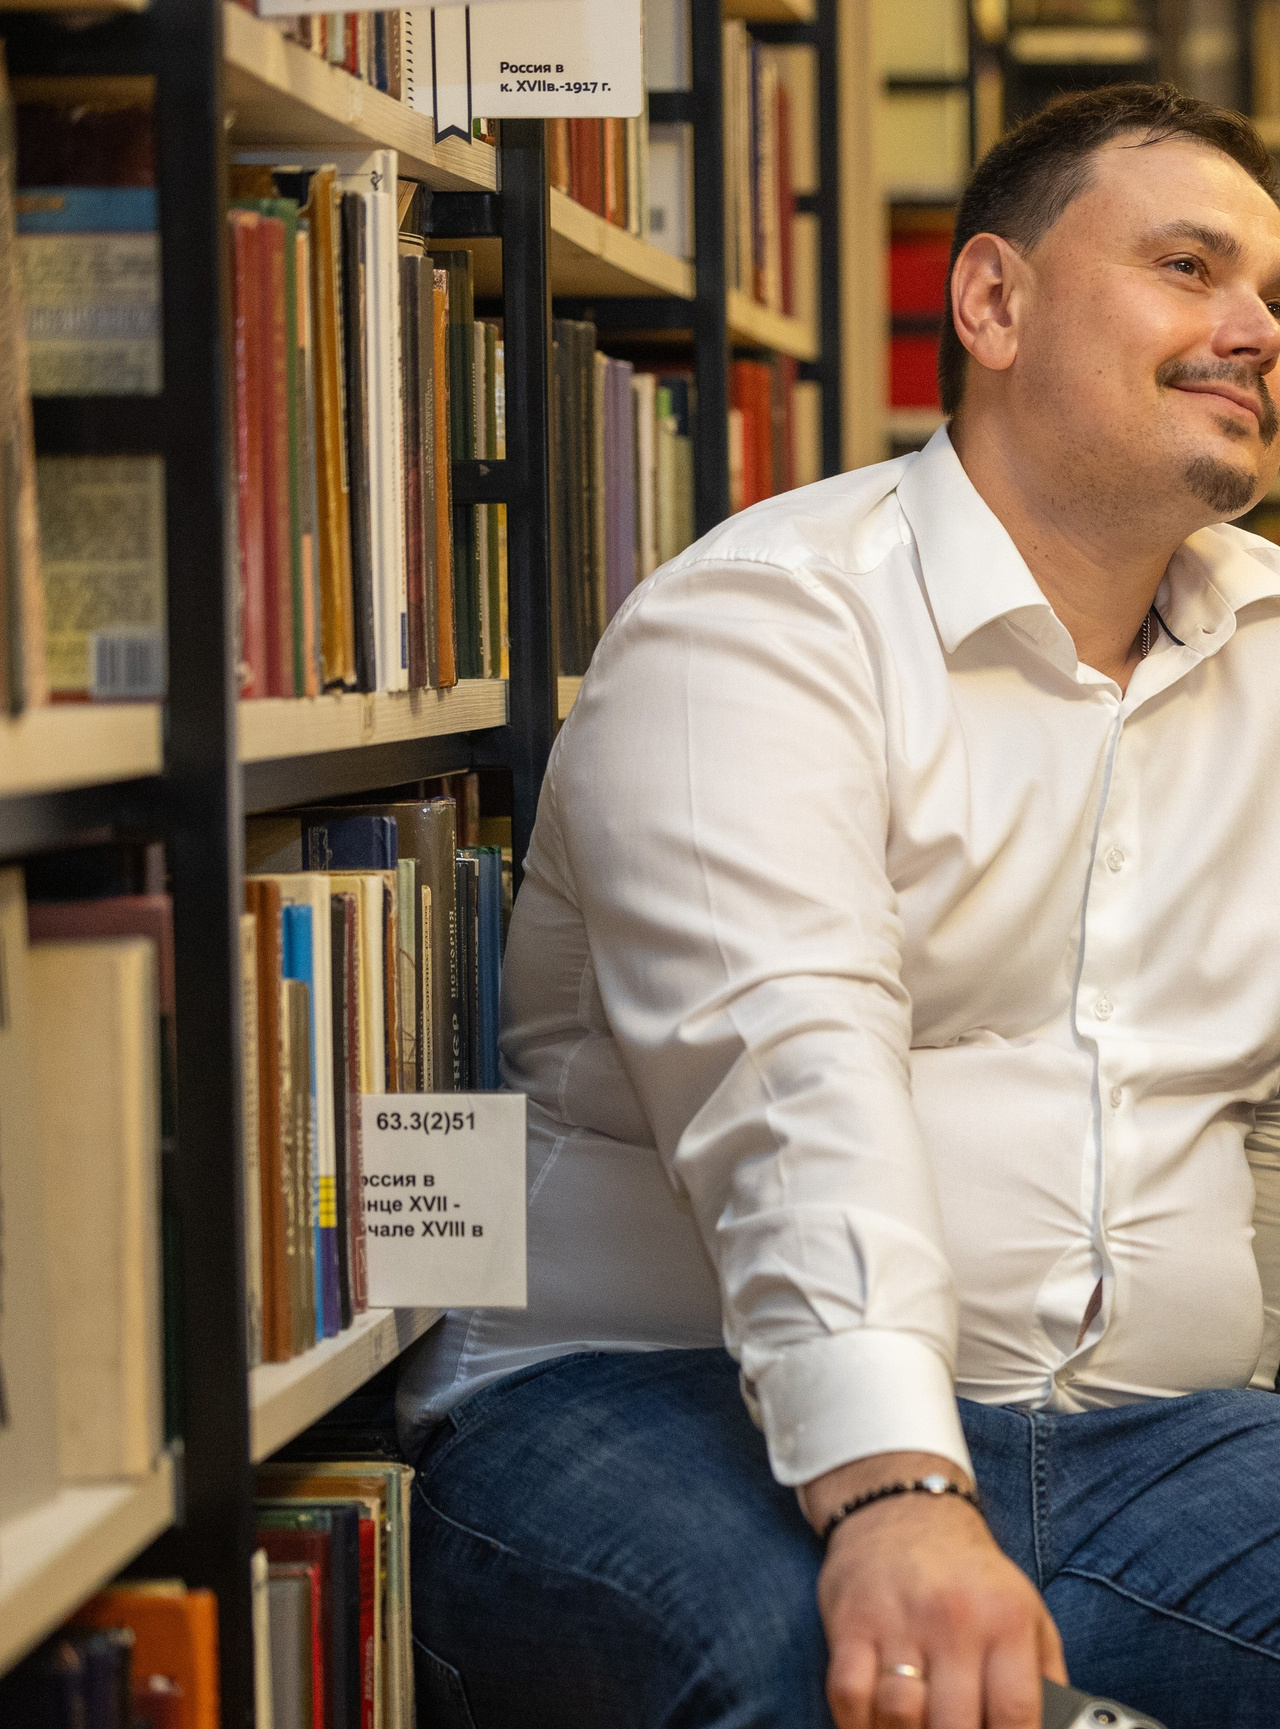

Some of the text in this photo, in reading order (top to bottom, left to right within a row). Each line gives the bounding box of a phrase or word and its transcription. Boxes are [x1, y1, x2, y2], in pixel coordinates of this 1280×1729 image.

[500, 61, 565, 74] Россия в
[500, 82, 513, 92] к.
[601, 82, 612, 92] г.
[376, 1112, 476, 1135] 63.3(2)51
[362, 1174, 435, 1188] оссия в
[363, 1199, 403, 1215] нце
[409, 1195, 448, 1212] XVII
[365, 1221, 484, 1238] чале XVIII в
